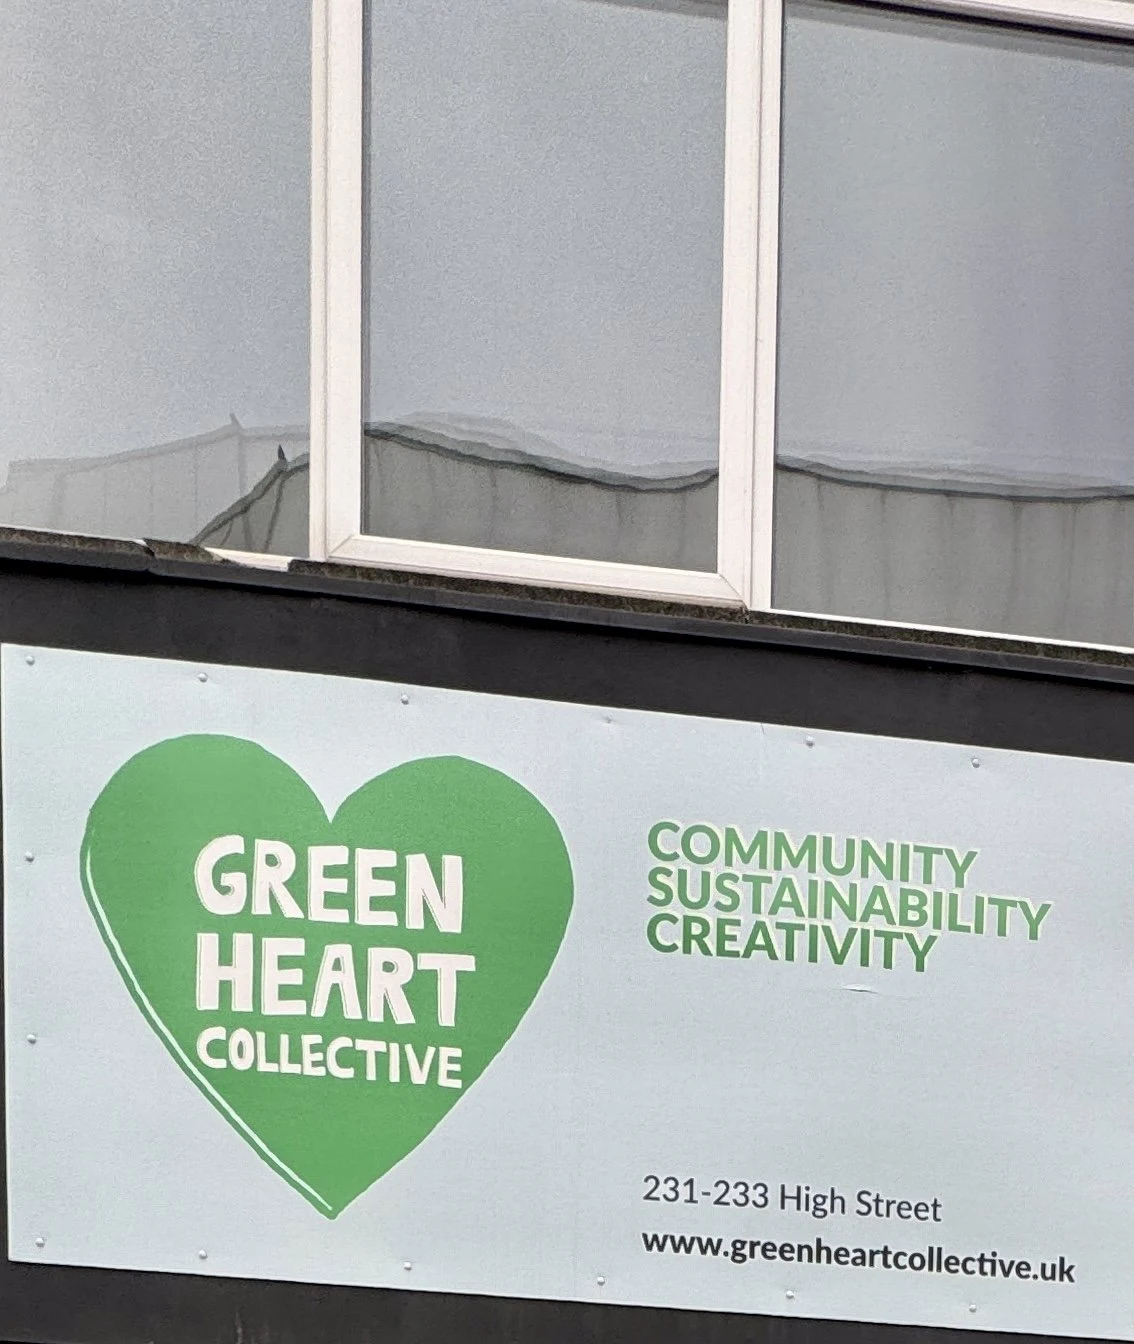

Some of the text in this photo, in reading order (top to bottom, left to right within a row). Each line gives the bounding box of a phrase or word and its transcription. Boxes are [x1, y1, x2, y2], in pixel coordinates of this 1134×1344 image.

[194, 834, 463, 933] GREEN
[646, 820, 978, 889] COMMUNITY
[646, 866, 1052, 941] SUSTAINABILITY
[646, 912, 938, 973] CREATIVITY
[196, 933, 476, 1027] HEART
[196, 1026, 463, 1089] COLLECTIVE
[642, 1174, 943, 1223] 231-233 High Street
[642, 1231, 1076, 1284] www.greenheartcollective.uk
